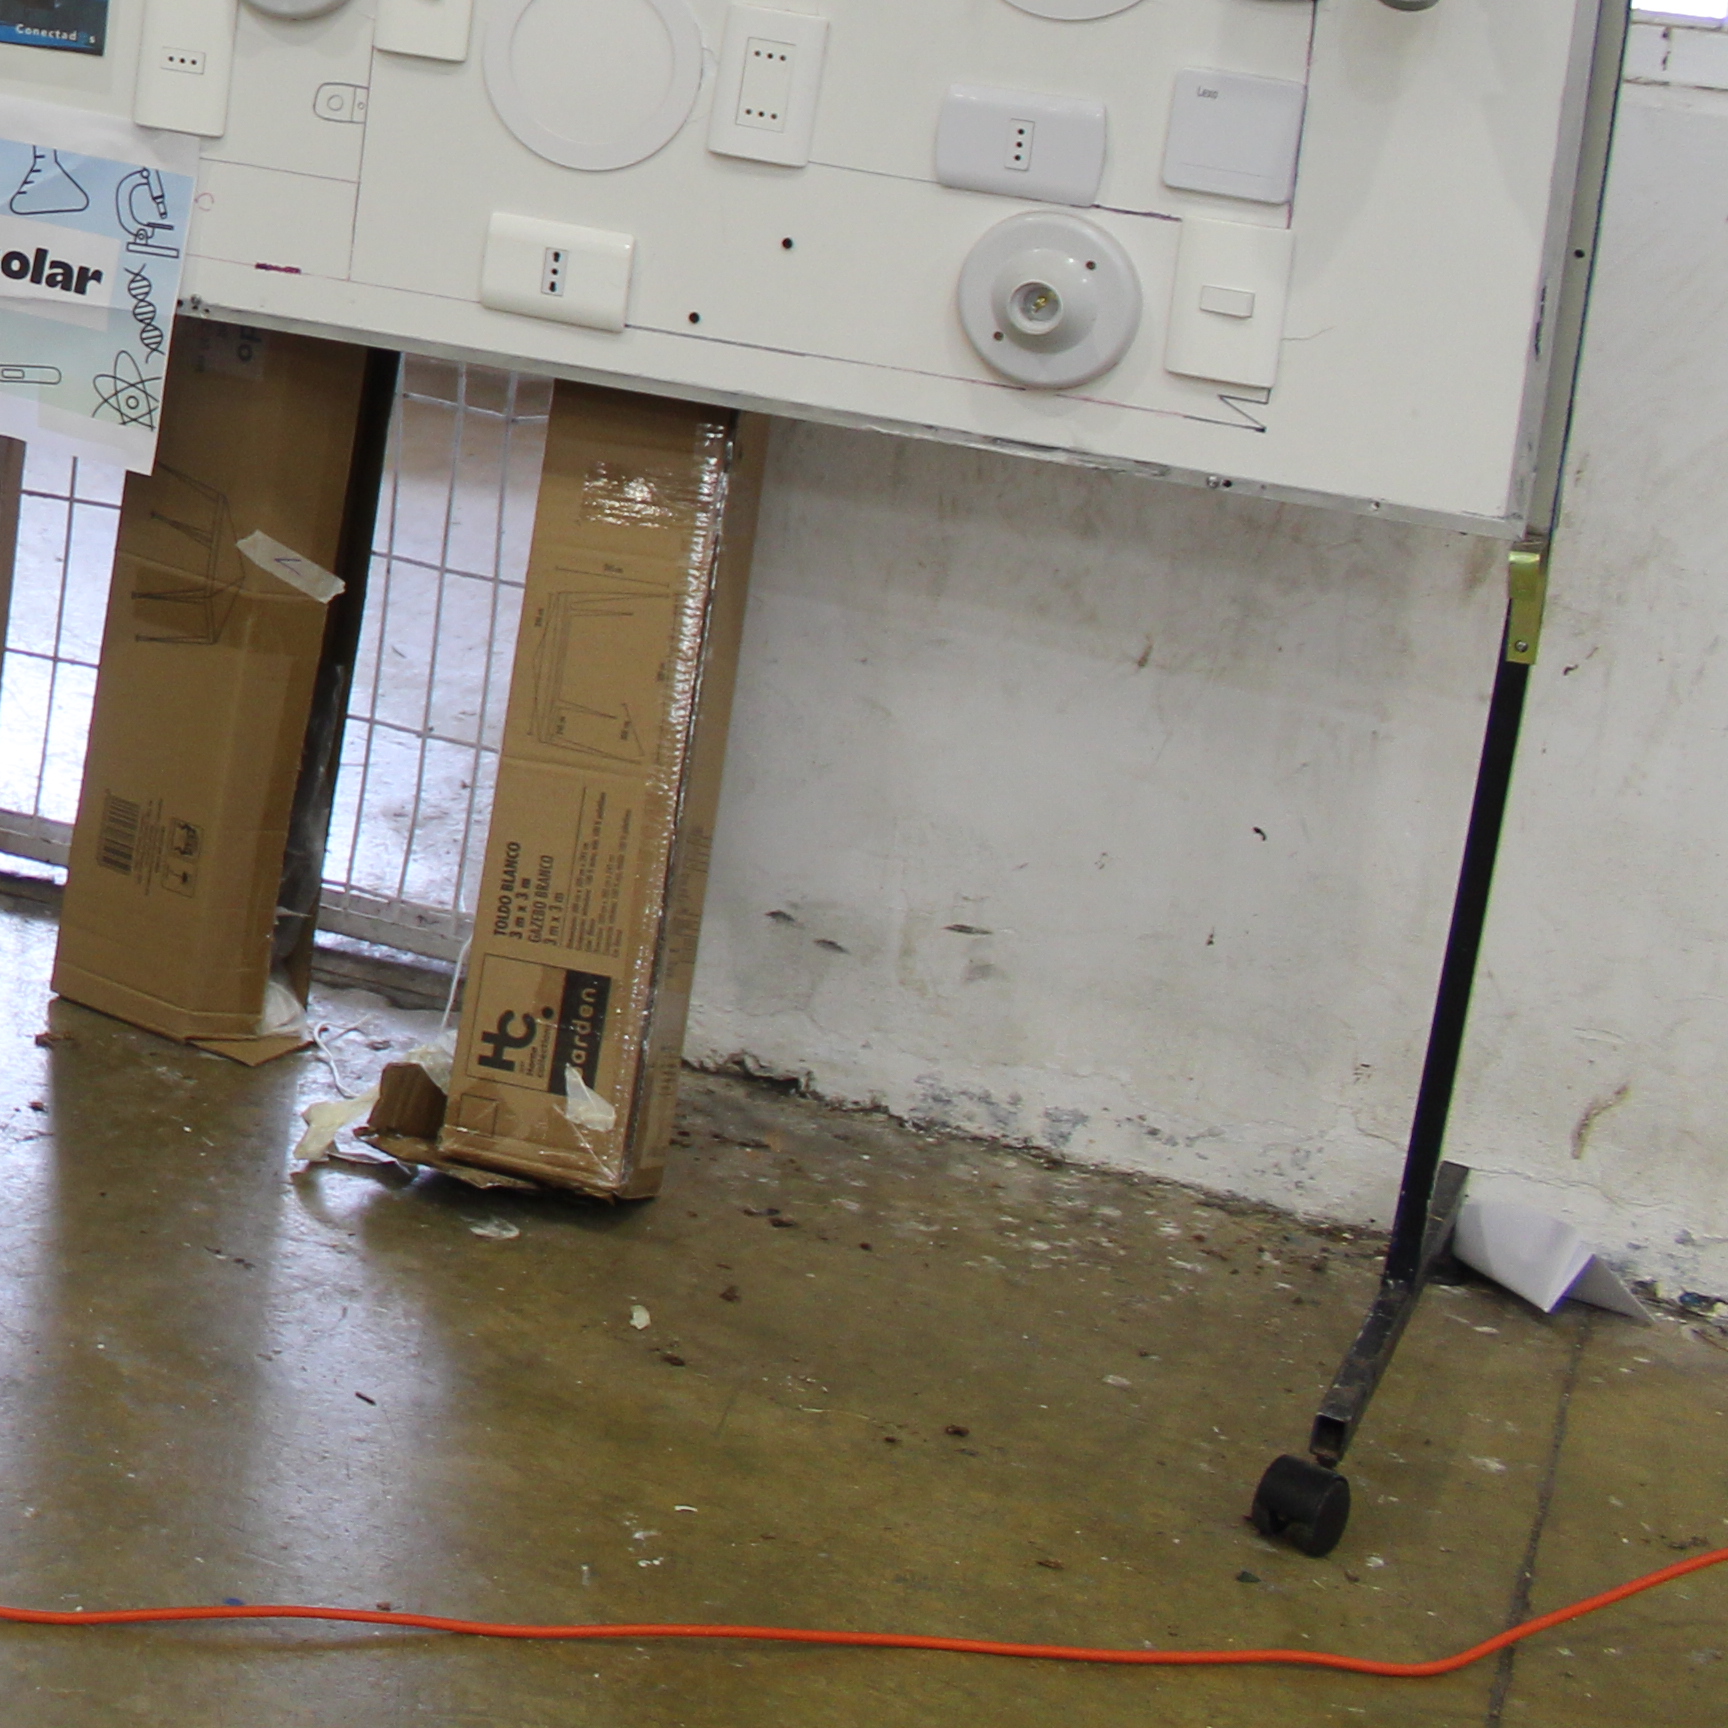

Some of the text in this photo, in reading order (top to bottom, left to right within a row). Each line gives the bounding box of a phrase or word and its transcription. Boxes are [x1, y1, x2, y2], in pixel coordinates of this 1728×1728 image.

[493, 841, 521, 937] TOLDO BLANCO
[520, 877, 532, 890] m
[516, 892, 529, 901] 3
[527, 854, 555, 943] GAZEBO BRANCO
[549, 904, 564, 912] 3
[514, 916, 526, 929] m
[509, 931, 523, 940] 3
[549, 925, 560, 937] m
[543, 938, 558, 946] 3
[565, 987, 598, 1078] arden
